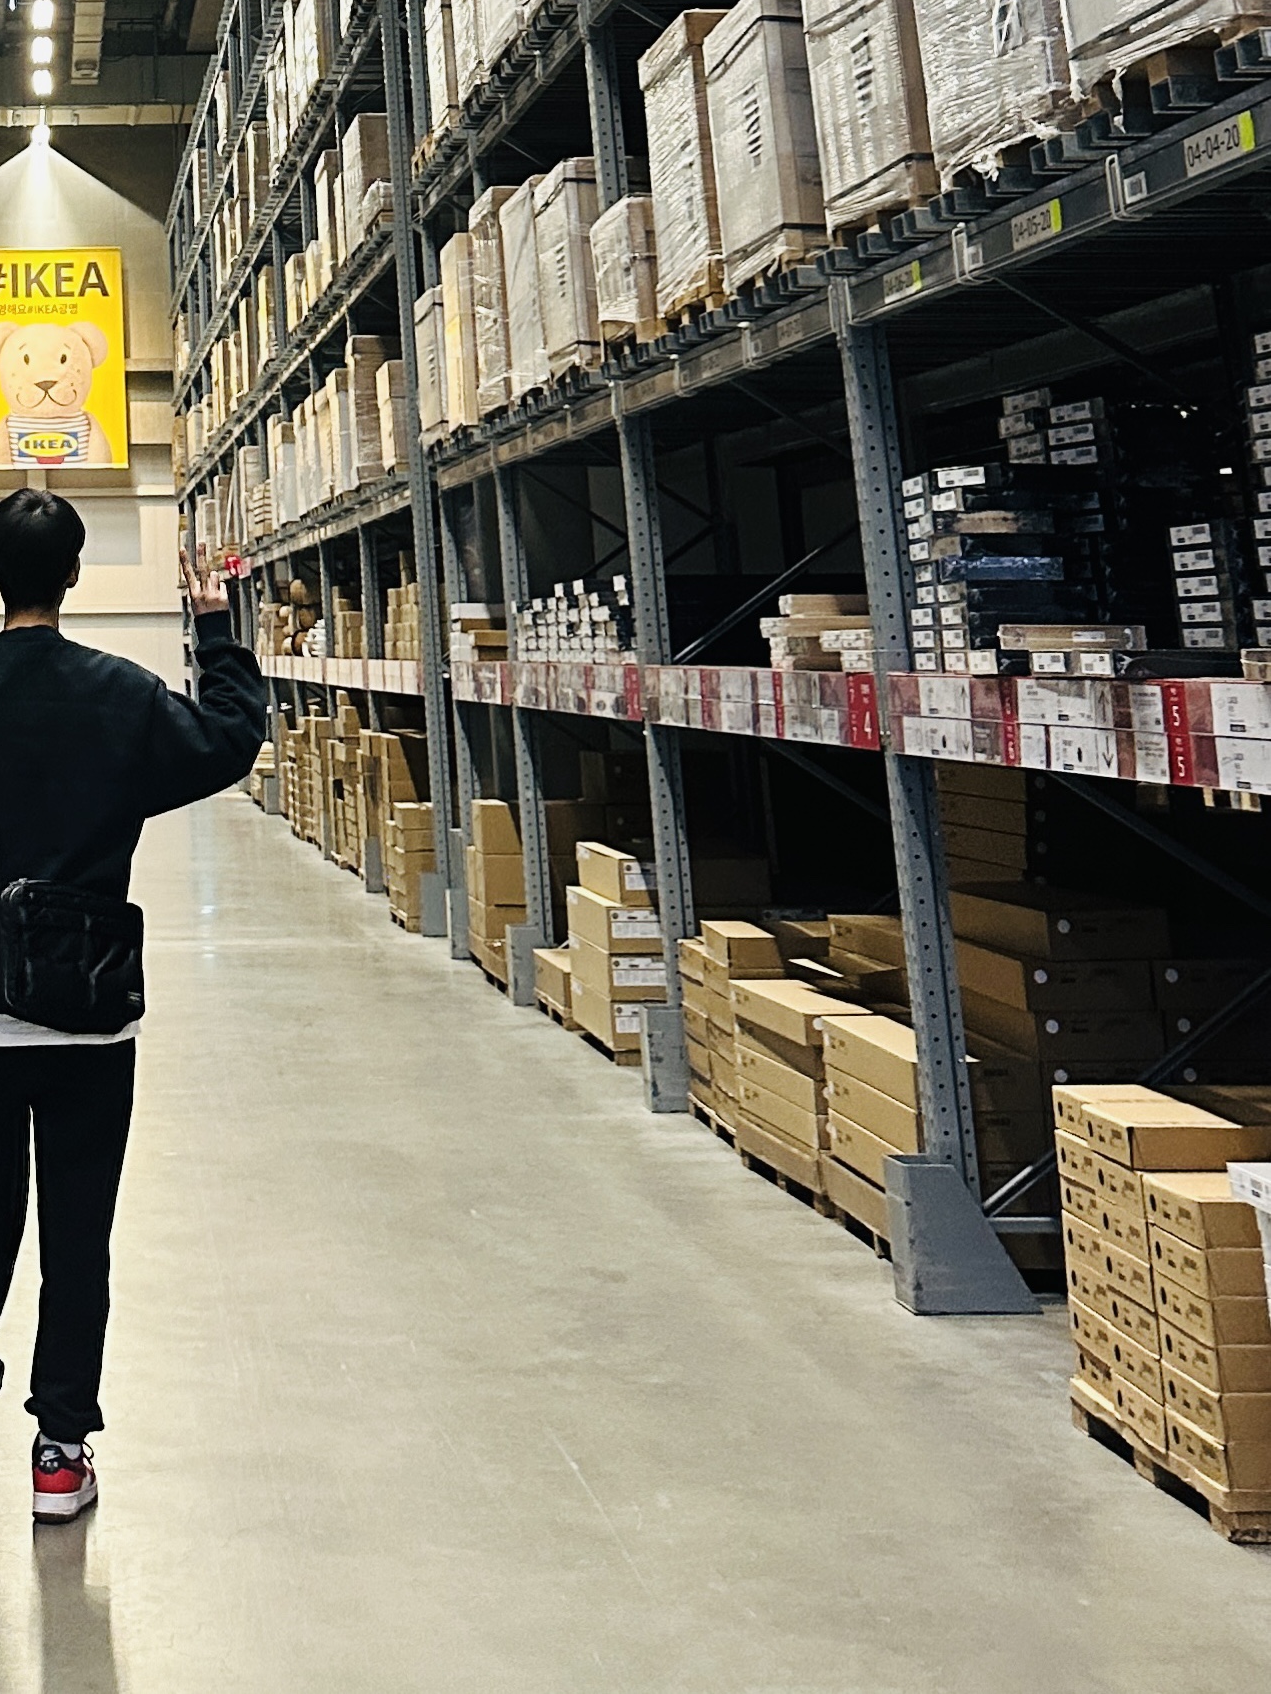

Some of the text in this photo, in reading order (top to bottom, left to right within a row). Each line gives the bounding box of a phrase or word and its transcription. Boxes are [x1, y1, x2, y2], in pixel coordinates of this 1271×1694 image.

[1187, 123, 1241, 168] 04-04-20
[24, 439, 73, 450] IKEA
[864, 711, 872, 740] 4
[1172, 705, 1180, 726] 5
[1177, 756, 1185, 777] 5
